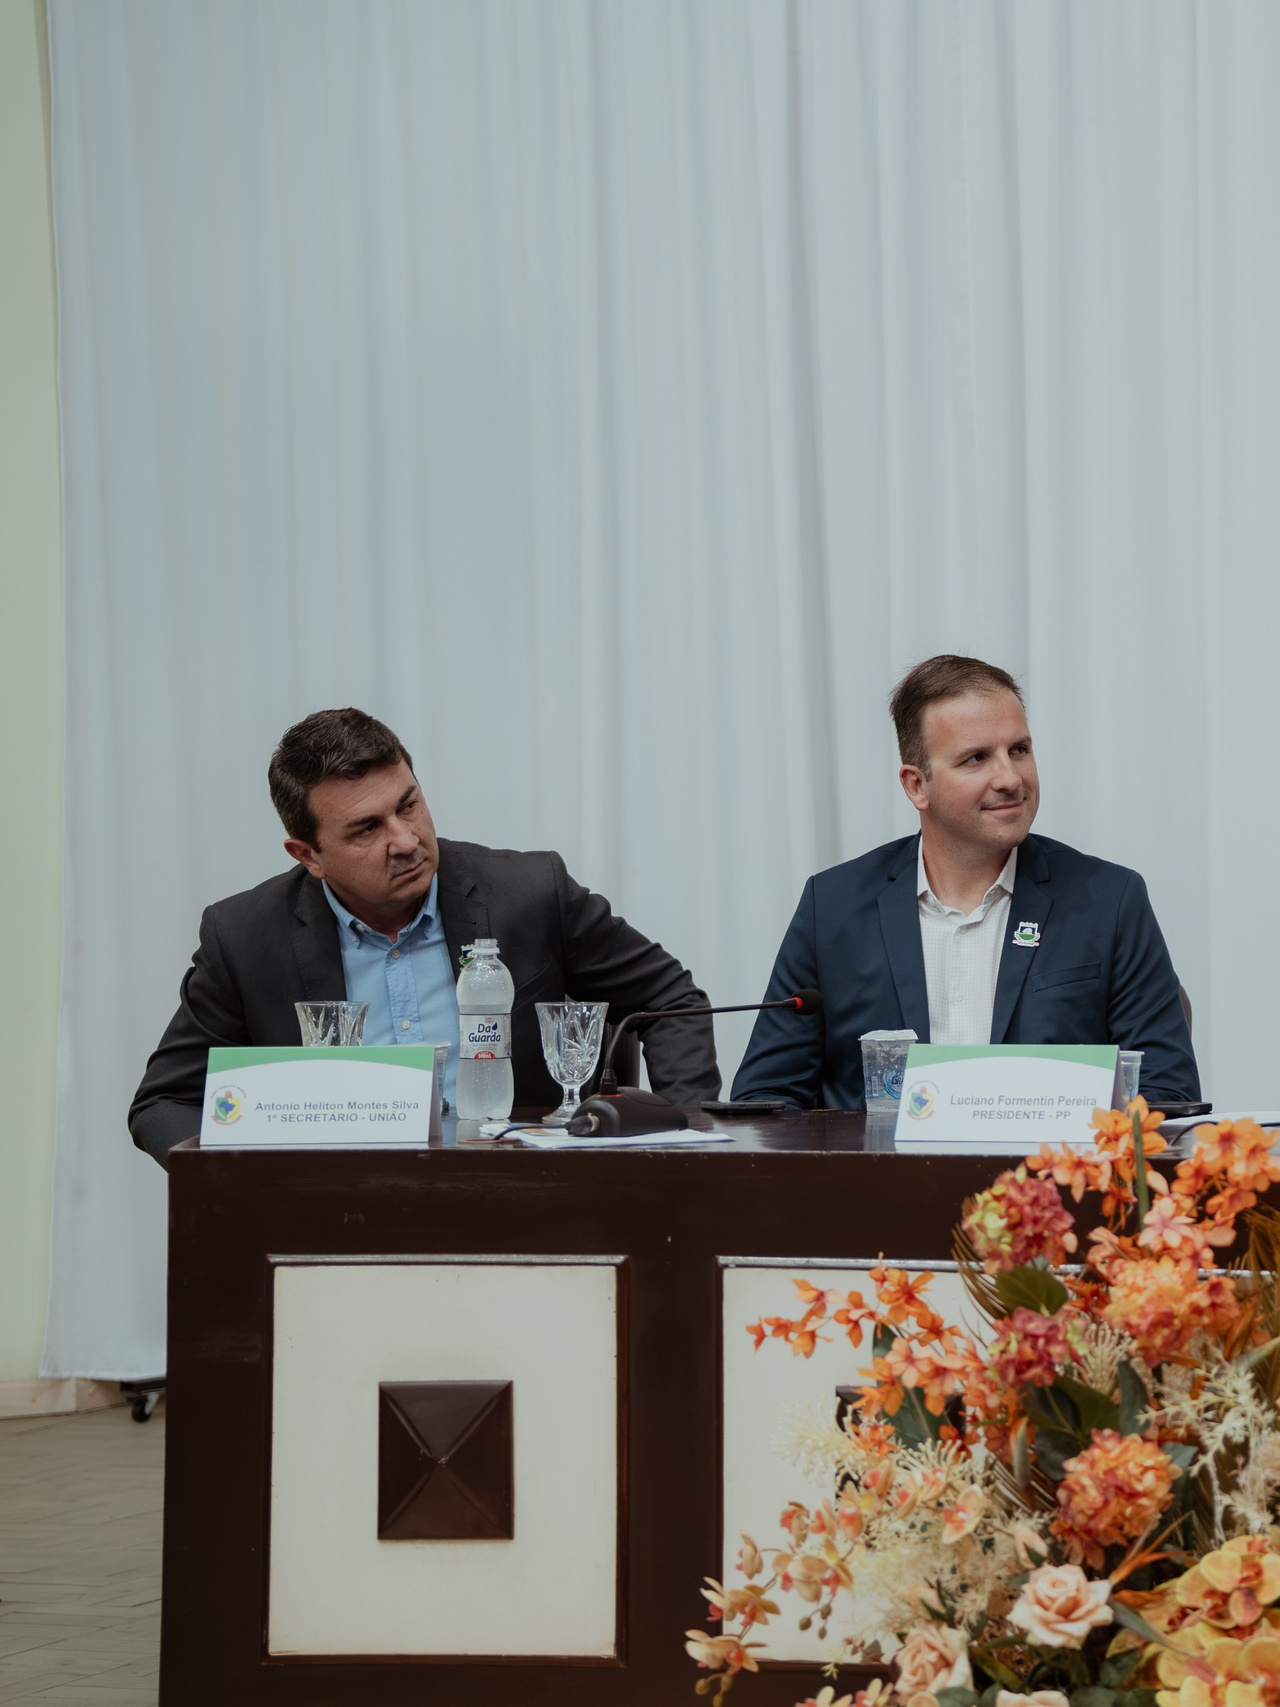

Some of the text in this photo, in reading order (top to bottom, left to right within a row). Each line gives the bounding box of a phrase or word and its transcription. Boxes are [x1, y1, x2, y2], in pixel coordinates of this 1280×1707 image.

[478, 1023, 491, 1033] Da
[468, 1032, 501, 1043] Guarda
[950, 1095, 1097, 1106] Luciano Formentin Pereira
[255, 1101, 419, 1111] Antonio Heliton Montes Silva
[280, 1112, 358, 1122] SECRETÁRIO
[369, 1112, 407, 1121] UNIÃO
[972, 1110, 1045, 1120] PRESIDENTE
[1056, 1111, 1071, 1120] PP
